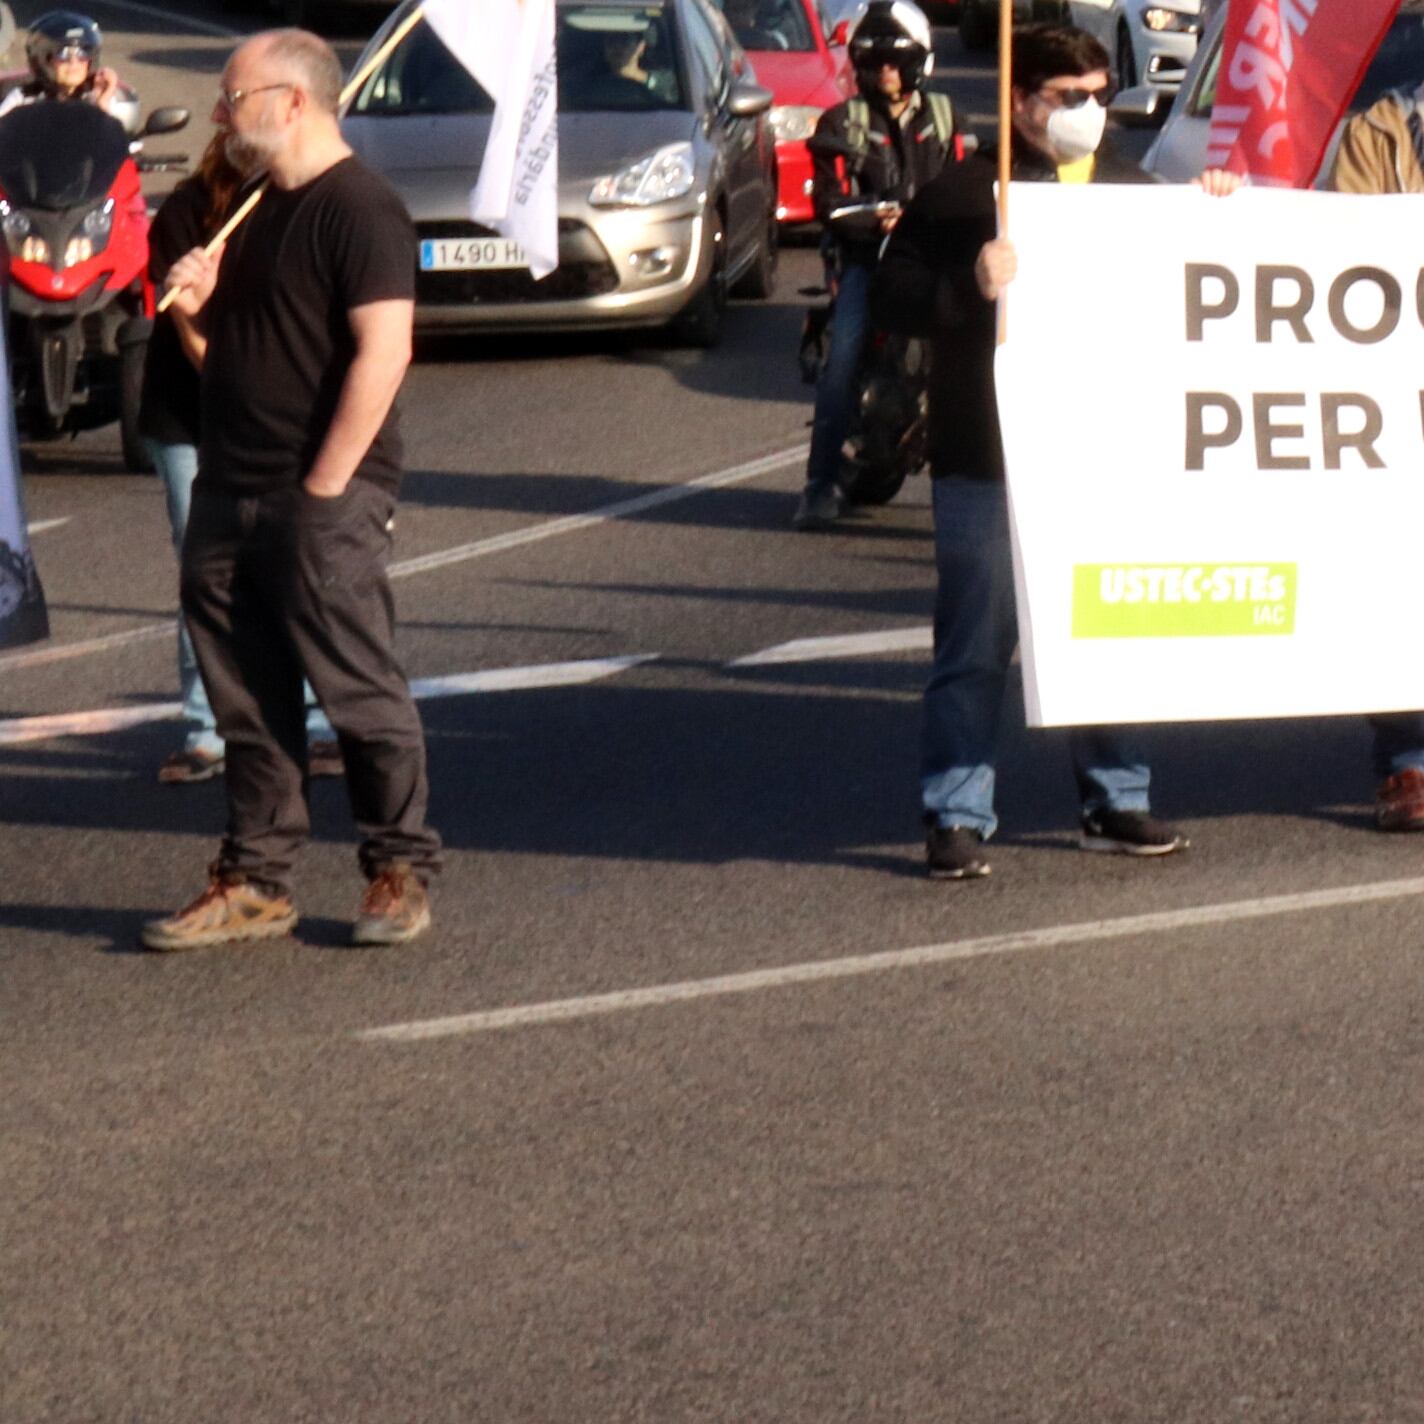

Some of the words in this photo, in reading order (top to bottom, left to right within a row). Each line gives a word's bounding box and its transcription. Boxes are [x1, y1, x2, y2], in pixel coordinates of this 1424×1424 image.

[440, 242, 496, 263] 1490
[1185, 392, 1385, 470] PER
[1253, 605, 1285, 625] IAC
